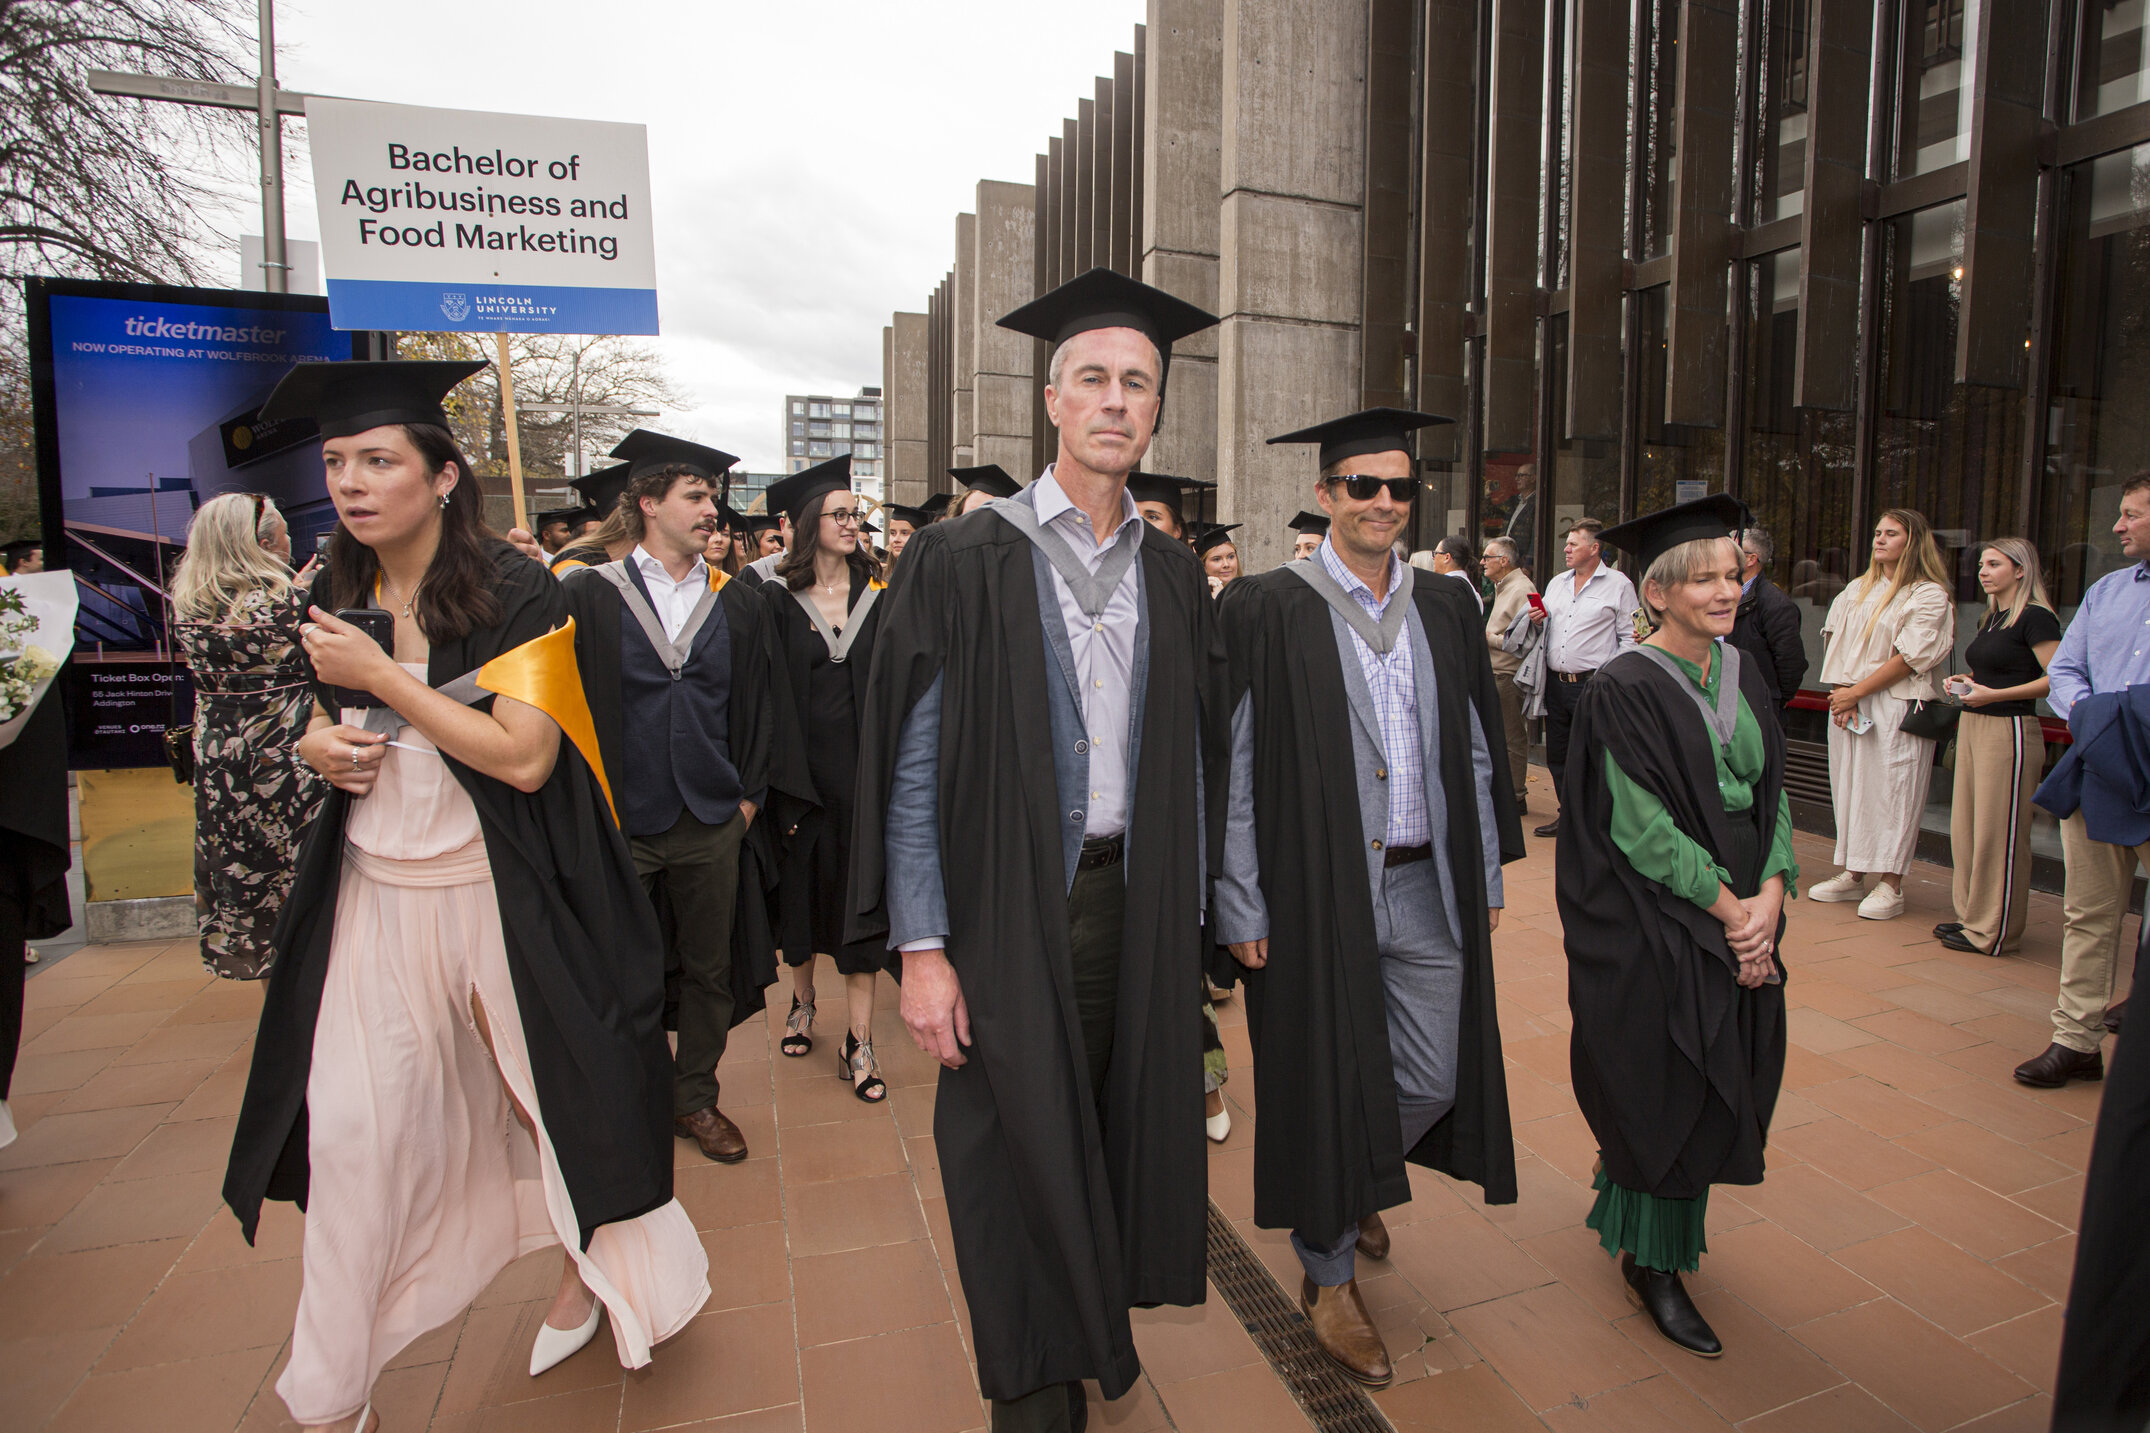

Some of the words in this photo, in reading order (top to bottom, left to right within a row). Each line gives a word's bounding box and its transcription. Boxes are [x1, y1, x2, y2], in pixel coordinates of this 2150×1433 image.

[388, 143, 538, 178] Bachelor
[548, 154, 580, 181] of
[341, 179, 561, 216] Agribusiness
[570, 194, 628, 220] and
[359, 218, 445, 248] Food
[455, 223, 618, 260] Marketing
[476, 296, 532, 305] LINCOLN
[476, 305, 556, 315] UNIVERSITY
[125, 315, 286, 344] ticketmaster
[72, 341, 106, 353] NOW
[108, 344, 185, 358] OPERATING
[187, 349, 205, 359] AT
[207, 350, 288, 363] WOLFBROOK
[290, 354, 330, 363] ARENA
[1559, 516, 1575, 539] 2
[90, 673, 127, 683] Ticket
[128, 673, 150, 682] Box
[92, 700, 136, 708] Addington
